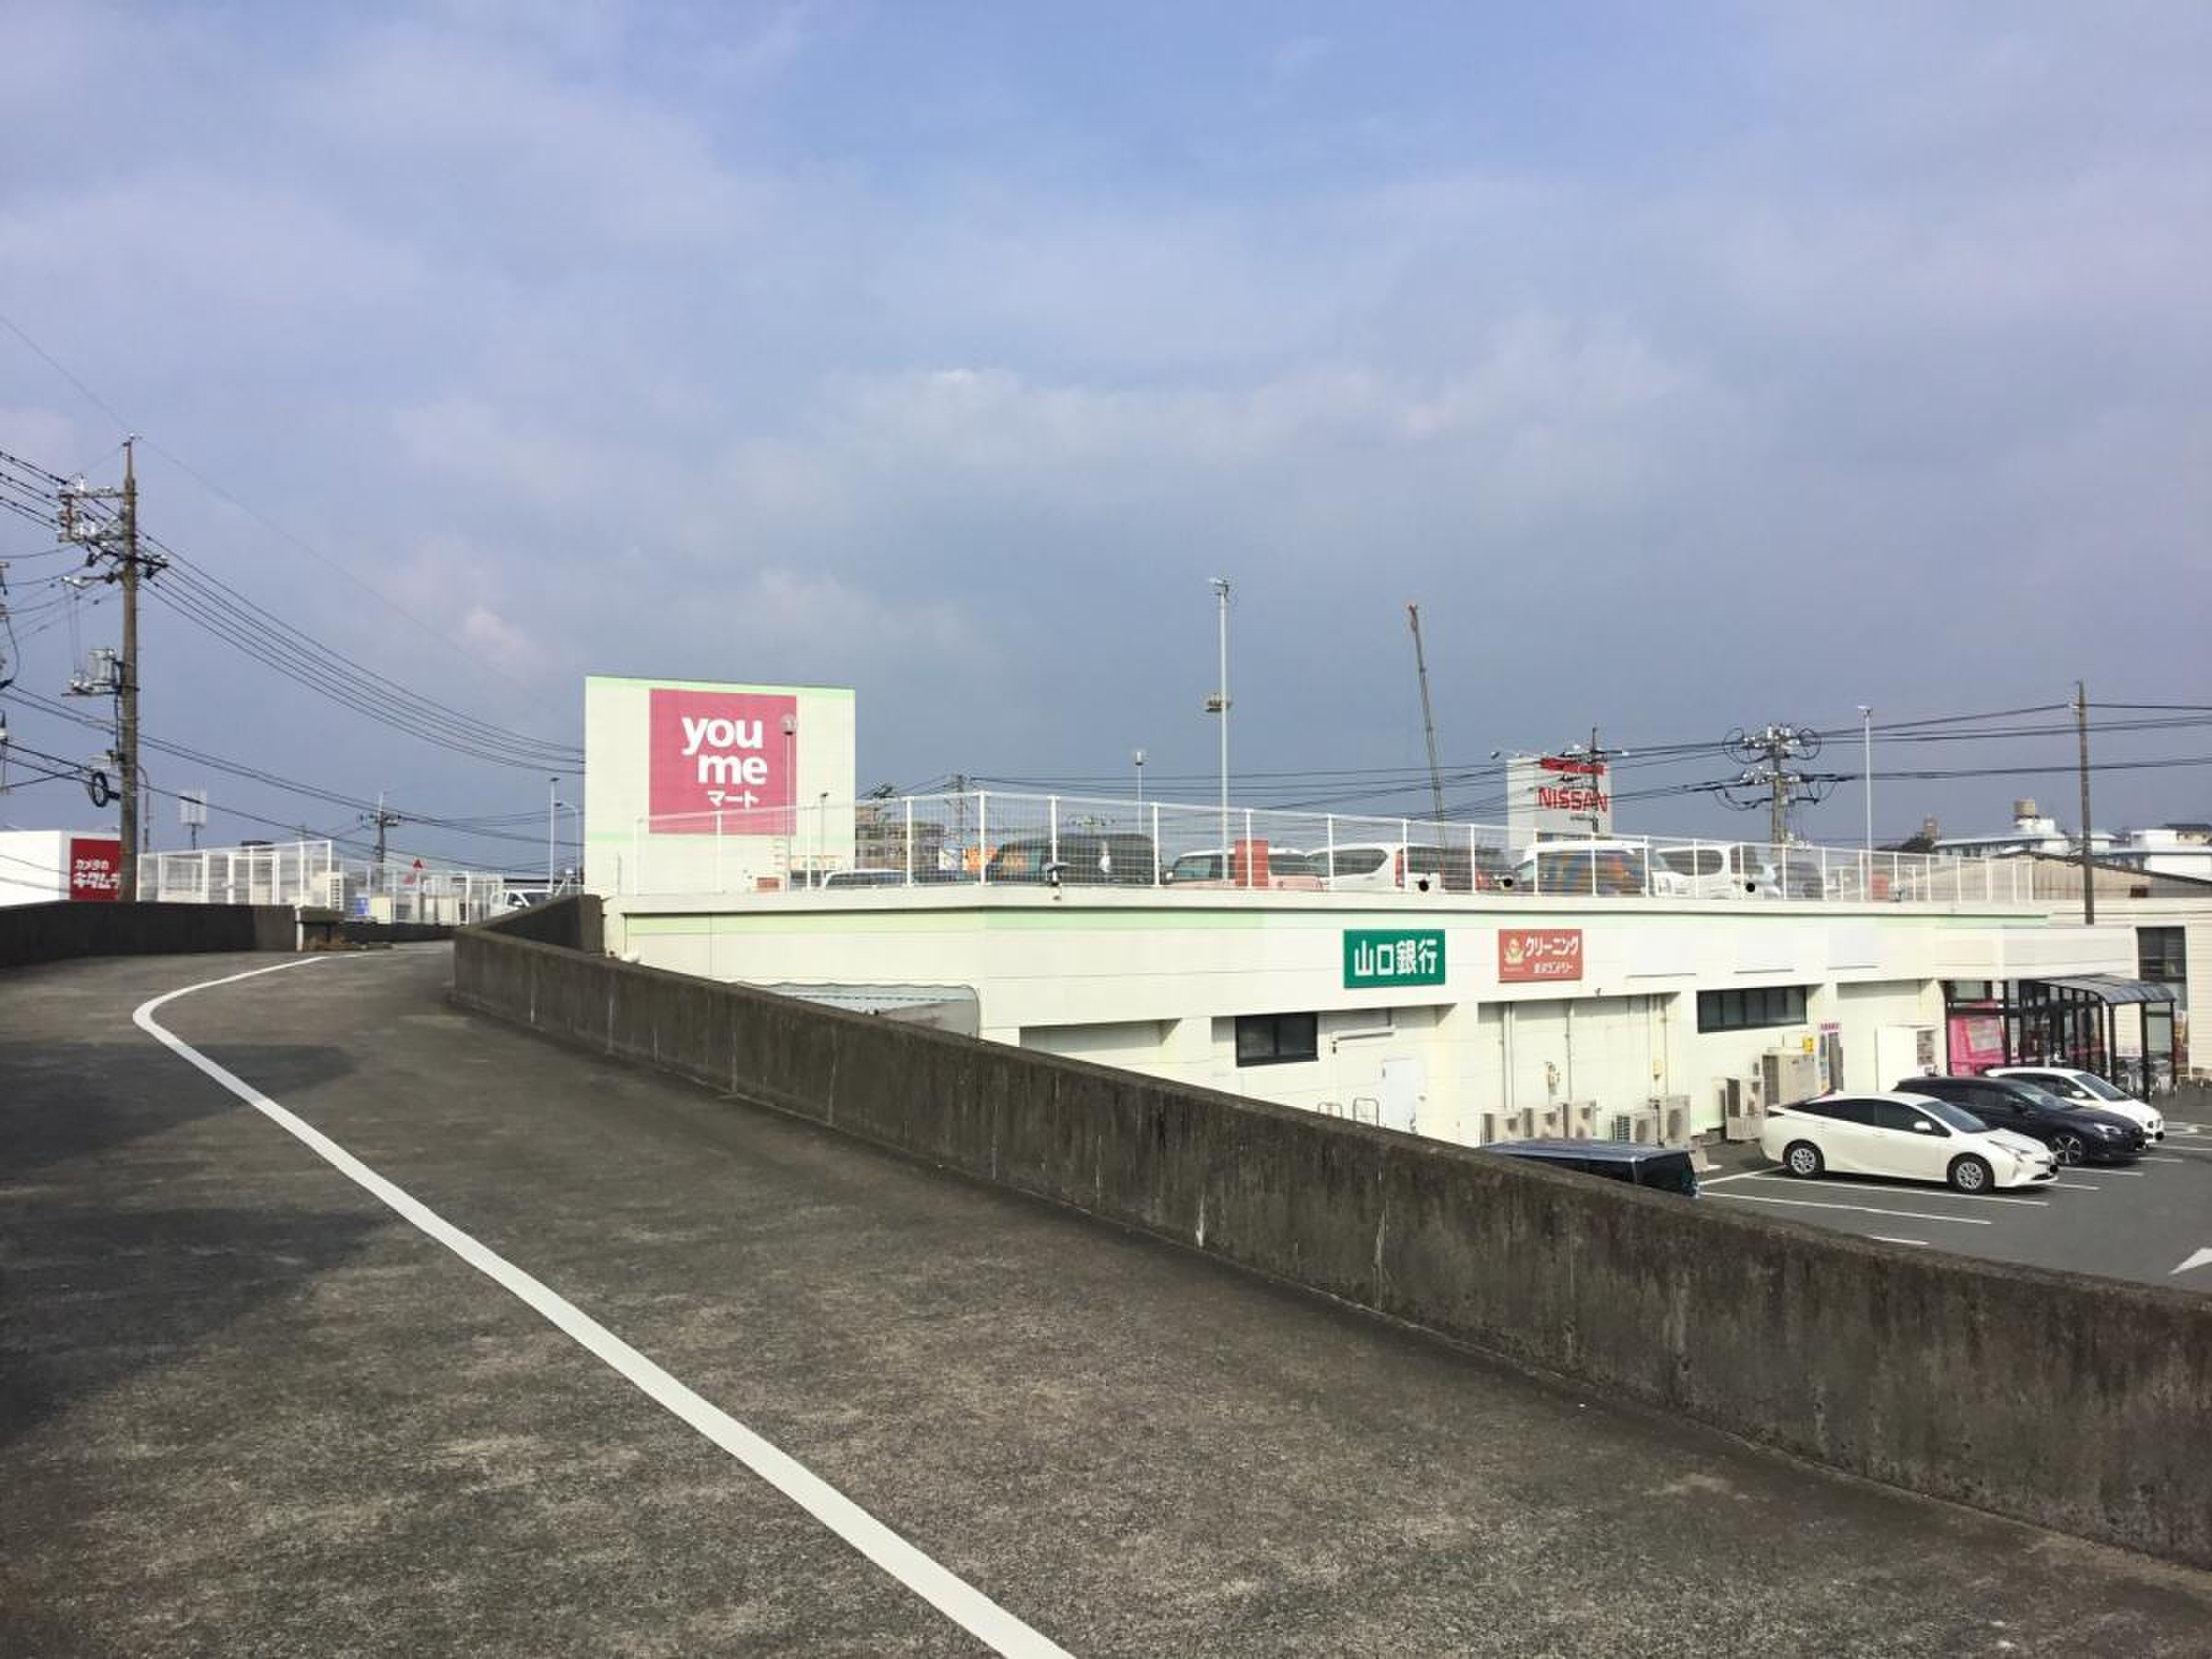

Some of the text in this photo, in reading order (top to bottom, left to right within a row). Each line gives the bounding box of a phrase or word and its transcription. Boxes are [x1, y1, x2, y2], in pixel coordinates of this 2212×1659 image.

[681, 716, 763, 756] you
[698, 754, 767, 784] me
[706, 790, 760, 809] マート
[1538, 786, 1607, 812] NISSAN
[1354, 938, 1438, 976] 山口銀行
[1525, 935, 1579, 957] クリーニング
